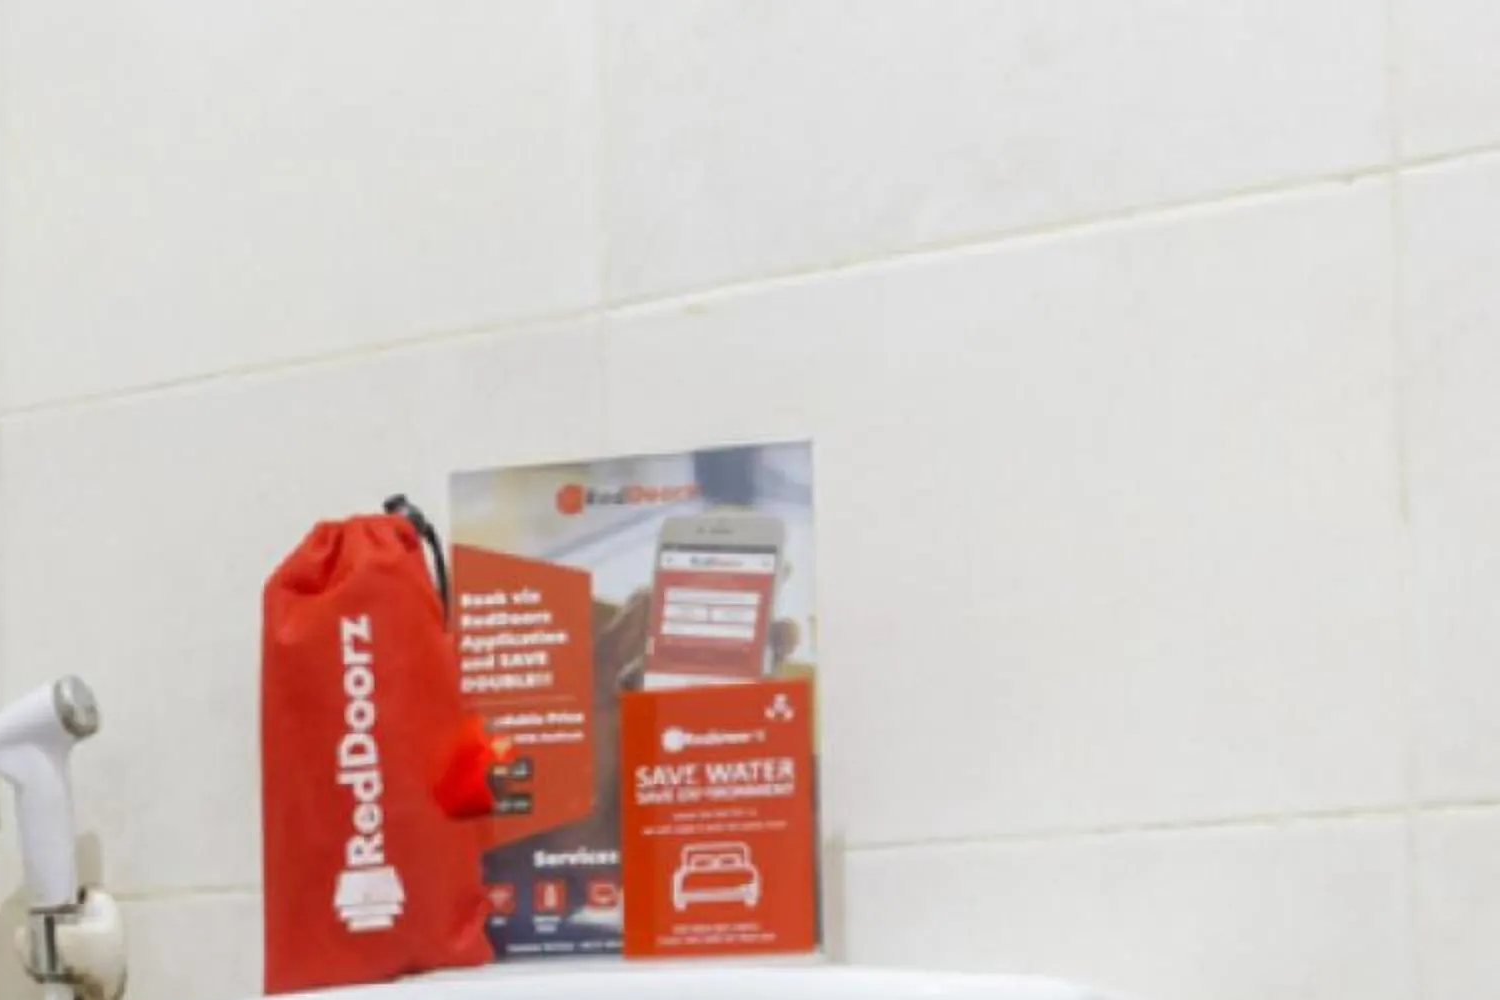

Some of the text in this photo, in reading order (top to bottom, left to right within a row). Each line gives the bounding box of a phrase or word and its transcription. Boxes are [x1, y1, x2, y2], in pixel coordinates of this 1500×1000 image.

[461, 588, 541, 607] Book via
[461, 631, 569, 652] Application
[461, 650, 548, 672] and SAVE
[337, 614, 384, 866] RedDoorz
[635, 756, 795, 787] SAVE WATER
[533, 847, 618, 868] Services
